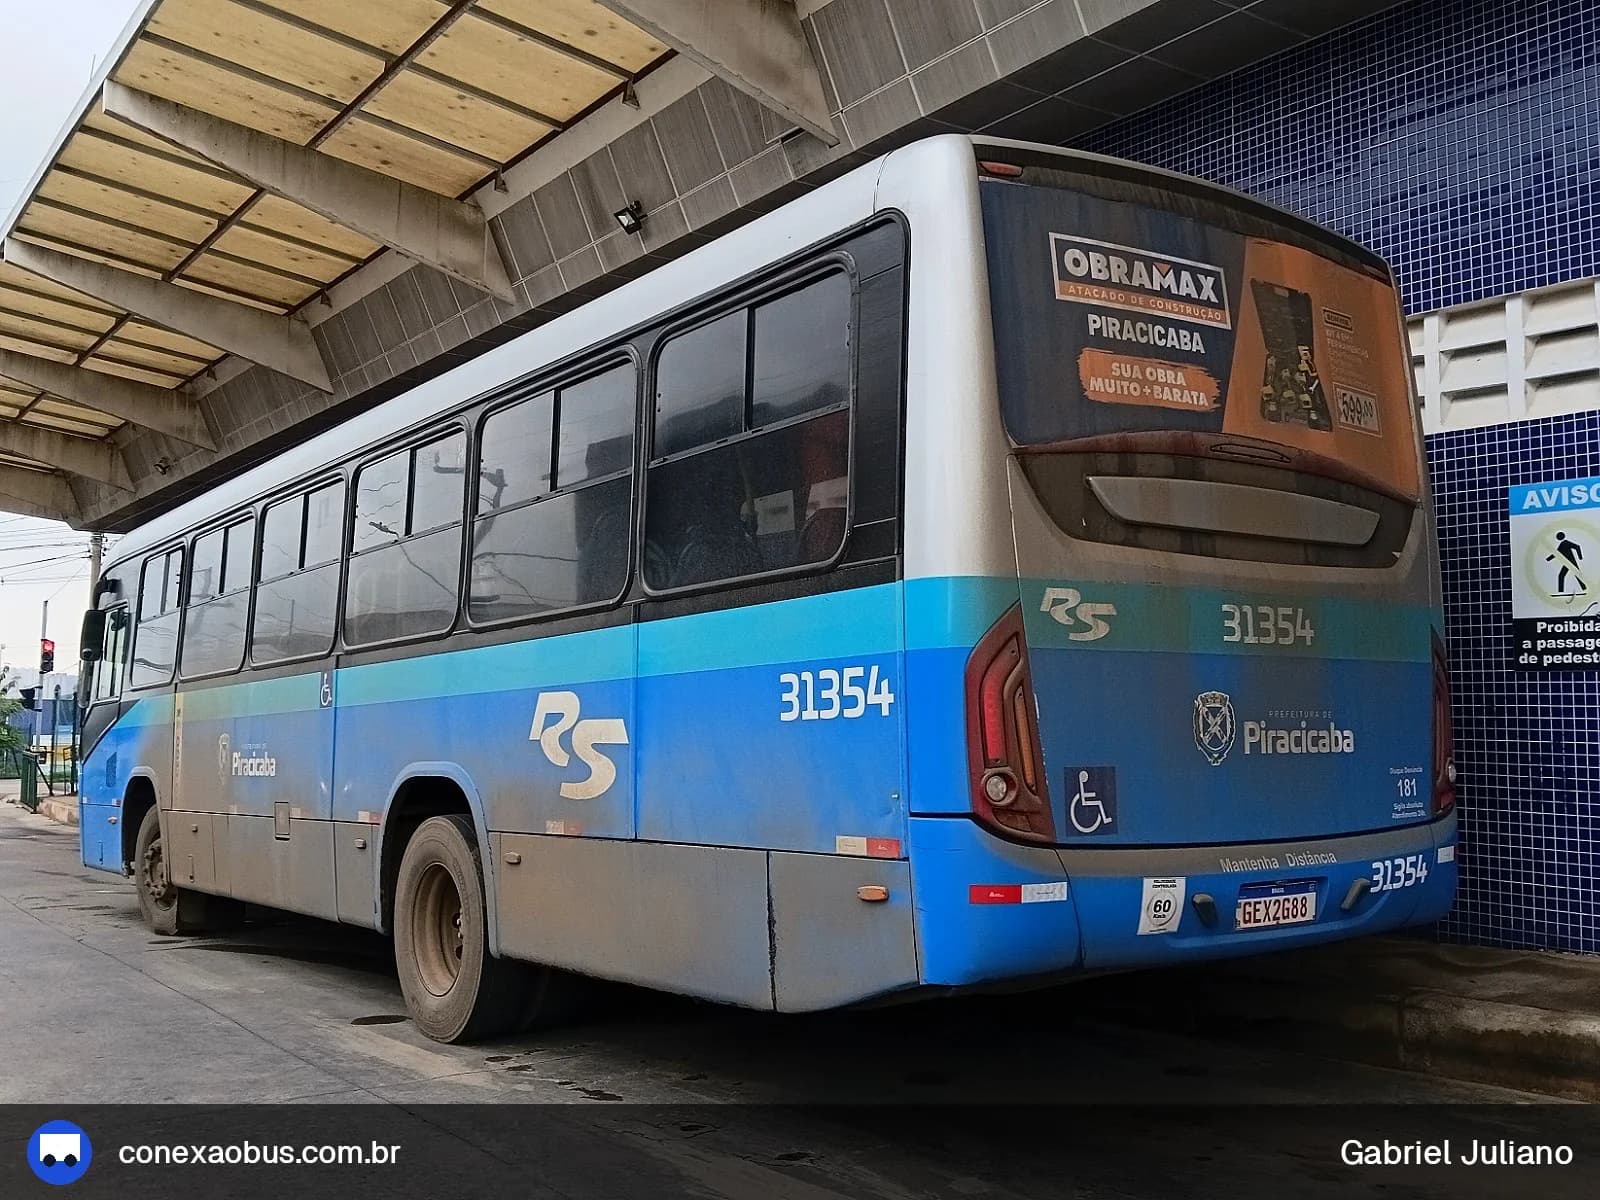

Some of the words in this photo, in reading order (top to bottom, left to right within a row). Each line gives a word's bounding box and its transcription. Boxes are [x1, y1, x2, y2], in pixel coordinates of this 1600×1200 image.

[1064, 248, 1219, 303] OBRAMAX
[1068, 285, 1126, 302] ATACADO
[1131, 295, 1145, 305] DE
[1149, 298, 1222, 322] CONSTRUÇÃO
[1087, 313, 1206, 354] PIRACICABA
[1111, 362, 1143, 380] SUA
[1145, 366, 1187, 386] OBRA
[1089, 376, 1140, 397] MUITO
[1152, 384, 1209, 407] BARATA
[1040, 587, 1118, 642] RS
[1221, 603, 1315, 647] 31354
[1536, 620, 1600, 633] Proibida
[1518, 652, 1538, 664] de
[1543, 651, 1600, 667] pedest
[1522, 640, 1532, 649] a
[779, 664, 895, 722] 31354
[1268, 710, 1320, 719] PREFEITURA
[1323, 711, 1333, 719] DE
[528, 690, 630, 801] RS
[1243, 720, 1355, 755] Piracicaba
[231, 752, 276, 777] Piracicaba
[1397, 778, 1417, 797] 181
[1219, 857, 1279, 873] Mantenha
[1287, 850, 1337, 868] Distância
[1369, 853, 1428, 893] 31354
[1153, 899, 1172, 913] 60
[1242, 895, 1308, 925] GEX2G88
